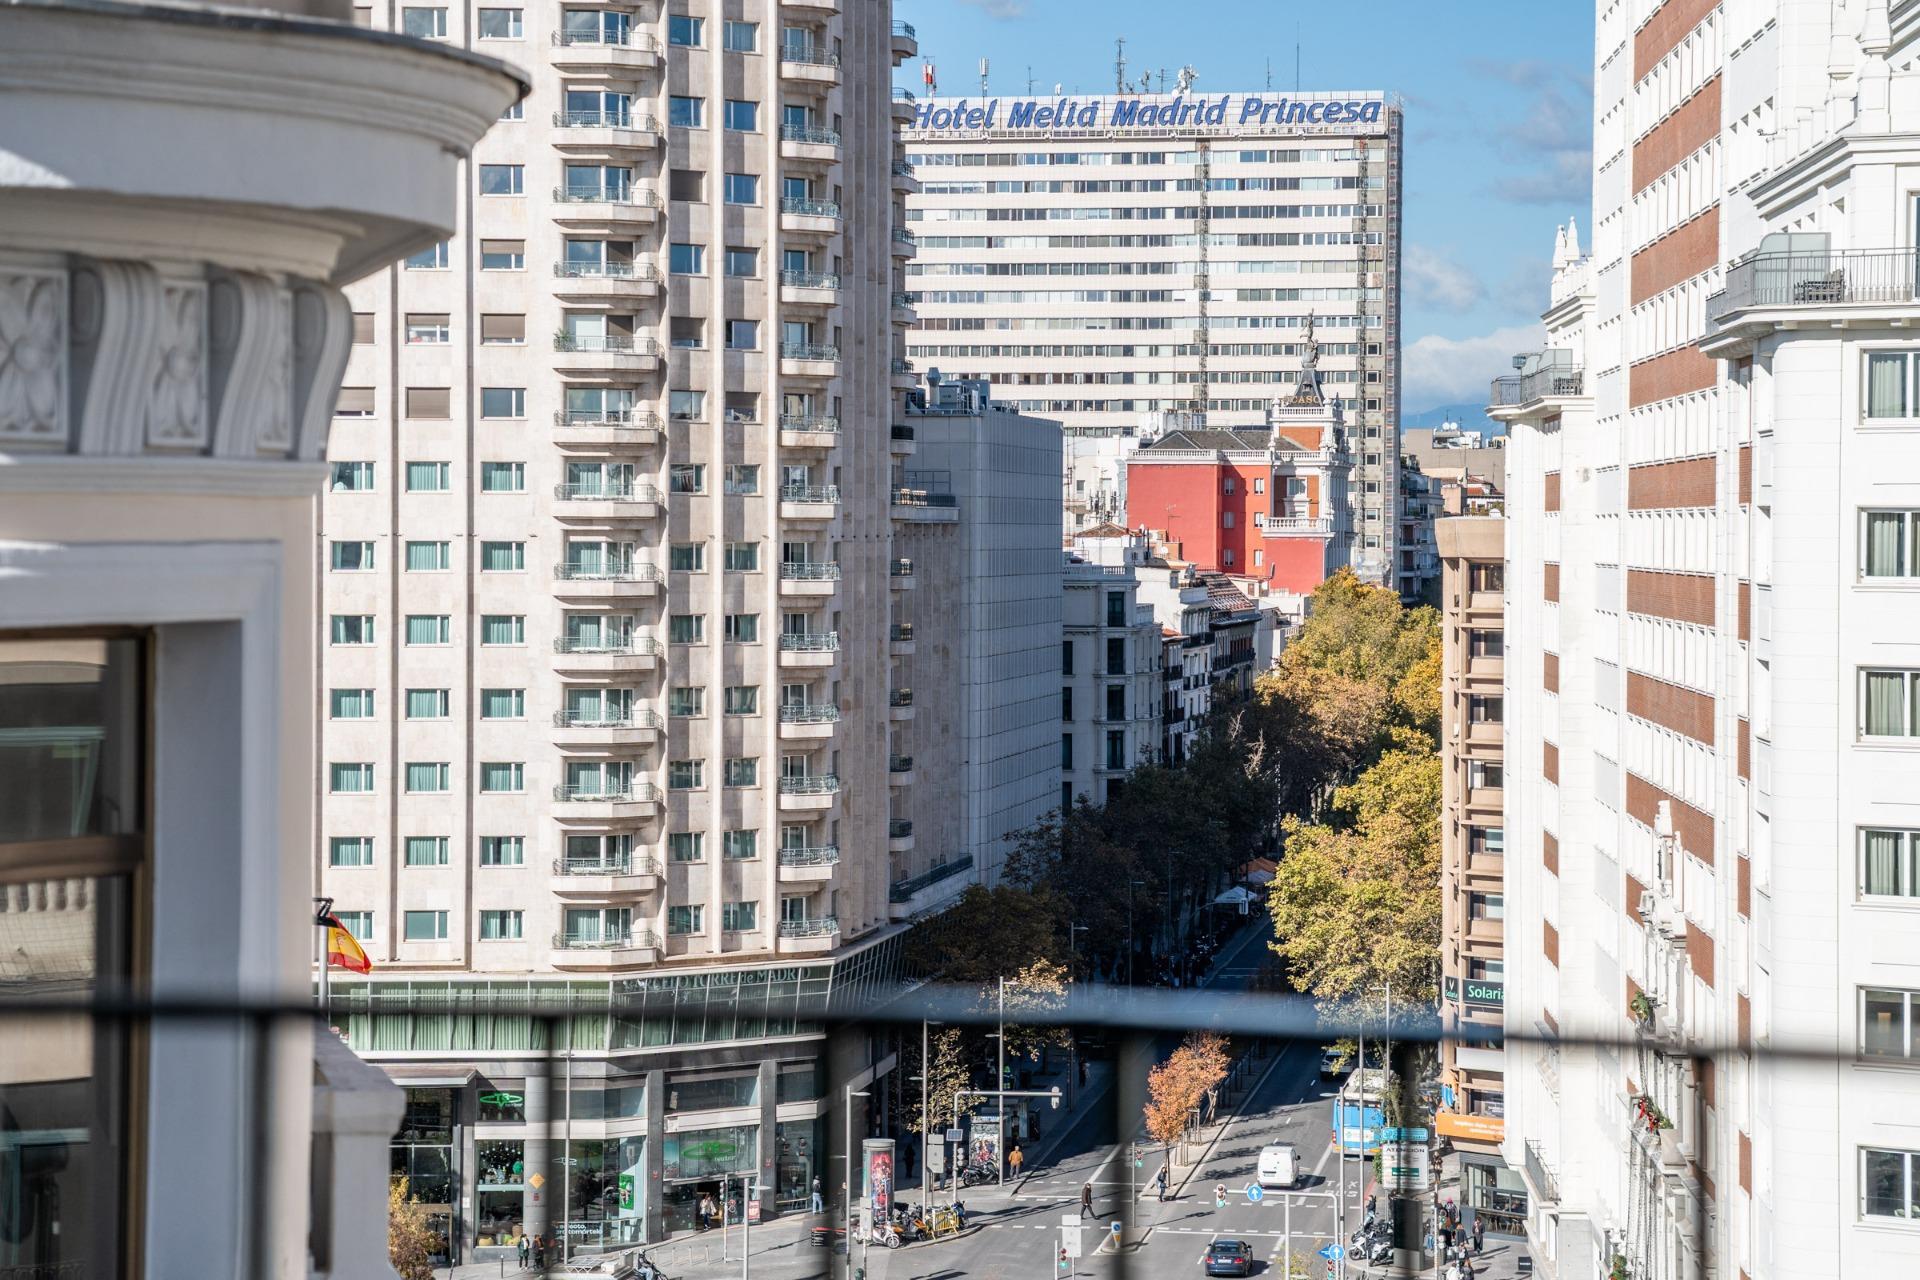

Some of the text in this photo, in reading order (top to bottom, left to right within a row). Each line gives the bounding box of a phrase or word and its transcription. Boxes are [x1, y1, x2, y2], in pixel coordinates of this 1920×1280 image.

[909, 98, 999, 129] Hotel
[1110, 94, 1230, 127] Madrid
[1238, 97, 1383, 125] Princesa
[740, 971, 753, 983] de
[756, 968, 810, 983] MADRD
